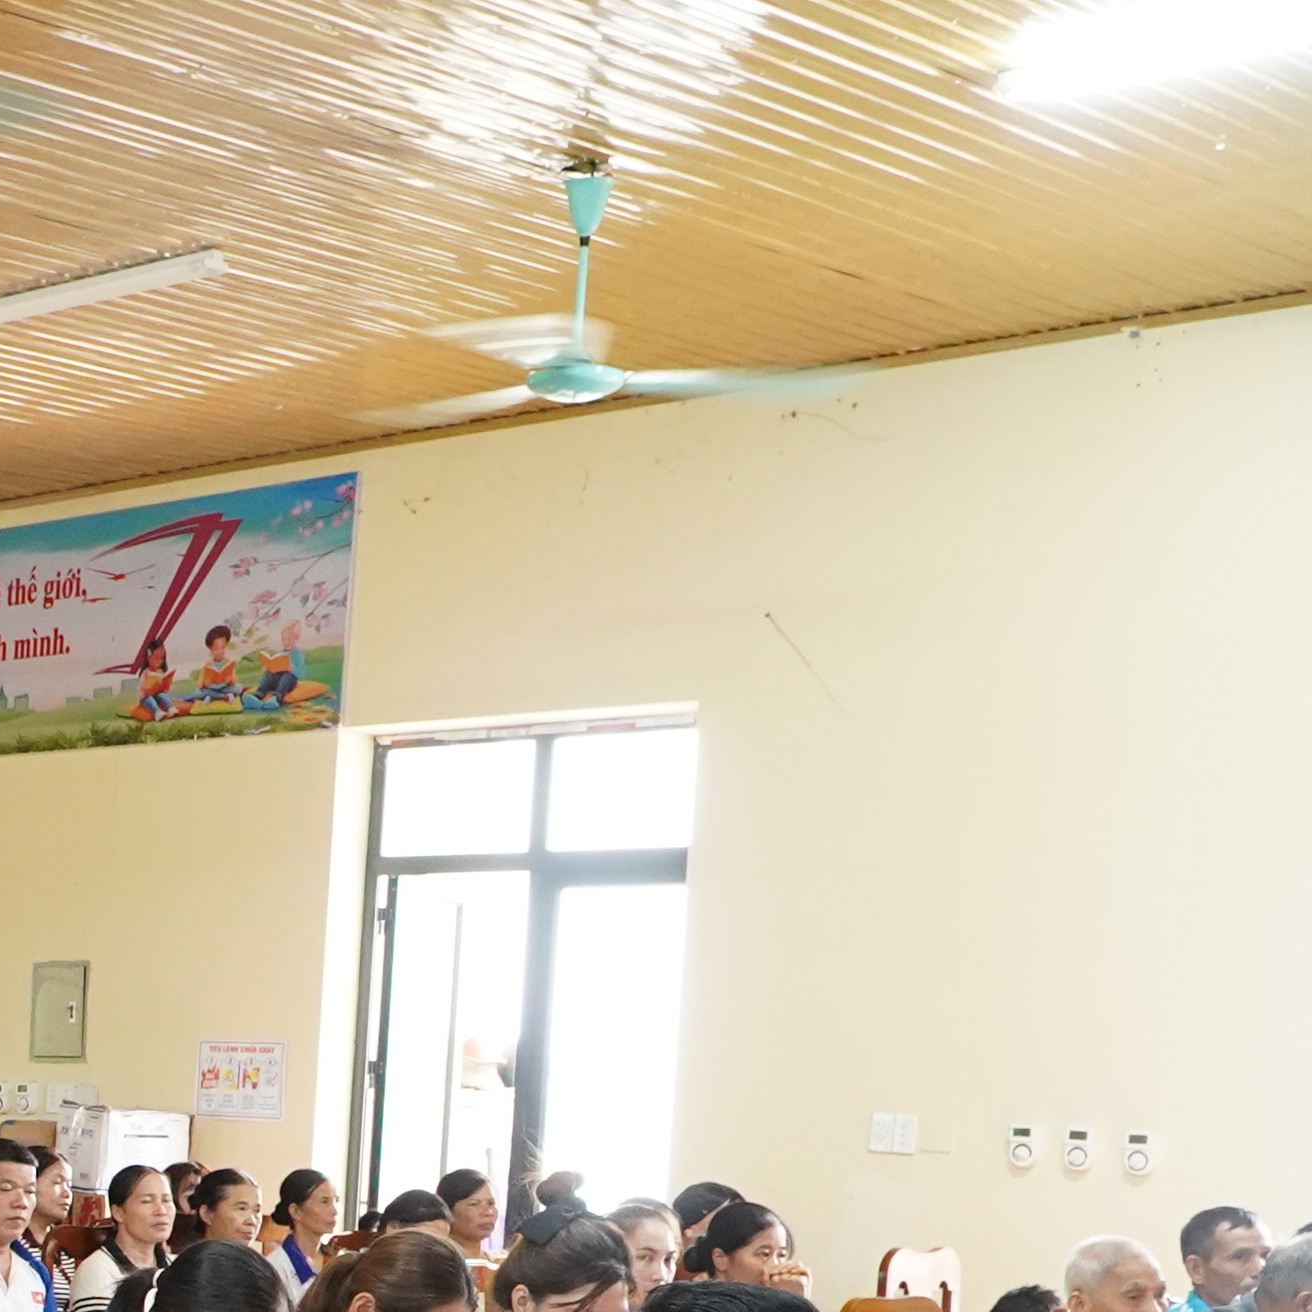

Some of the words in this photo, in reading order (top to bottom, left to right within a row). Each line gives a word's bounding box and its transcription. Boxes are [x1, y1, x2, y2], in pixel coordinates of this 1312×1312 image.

[7, 565, 37, 606] thế
[42, 568, 87, 609] giới,
[13, 627, 71, 660] mình.
